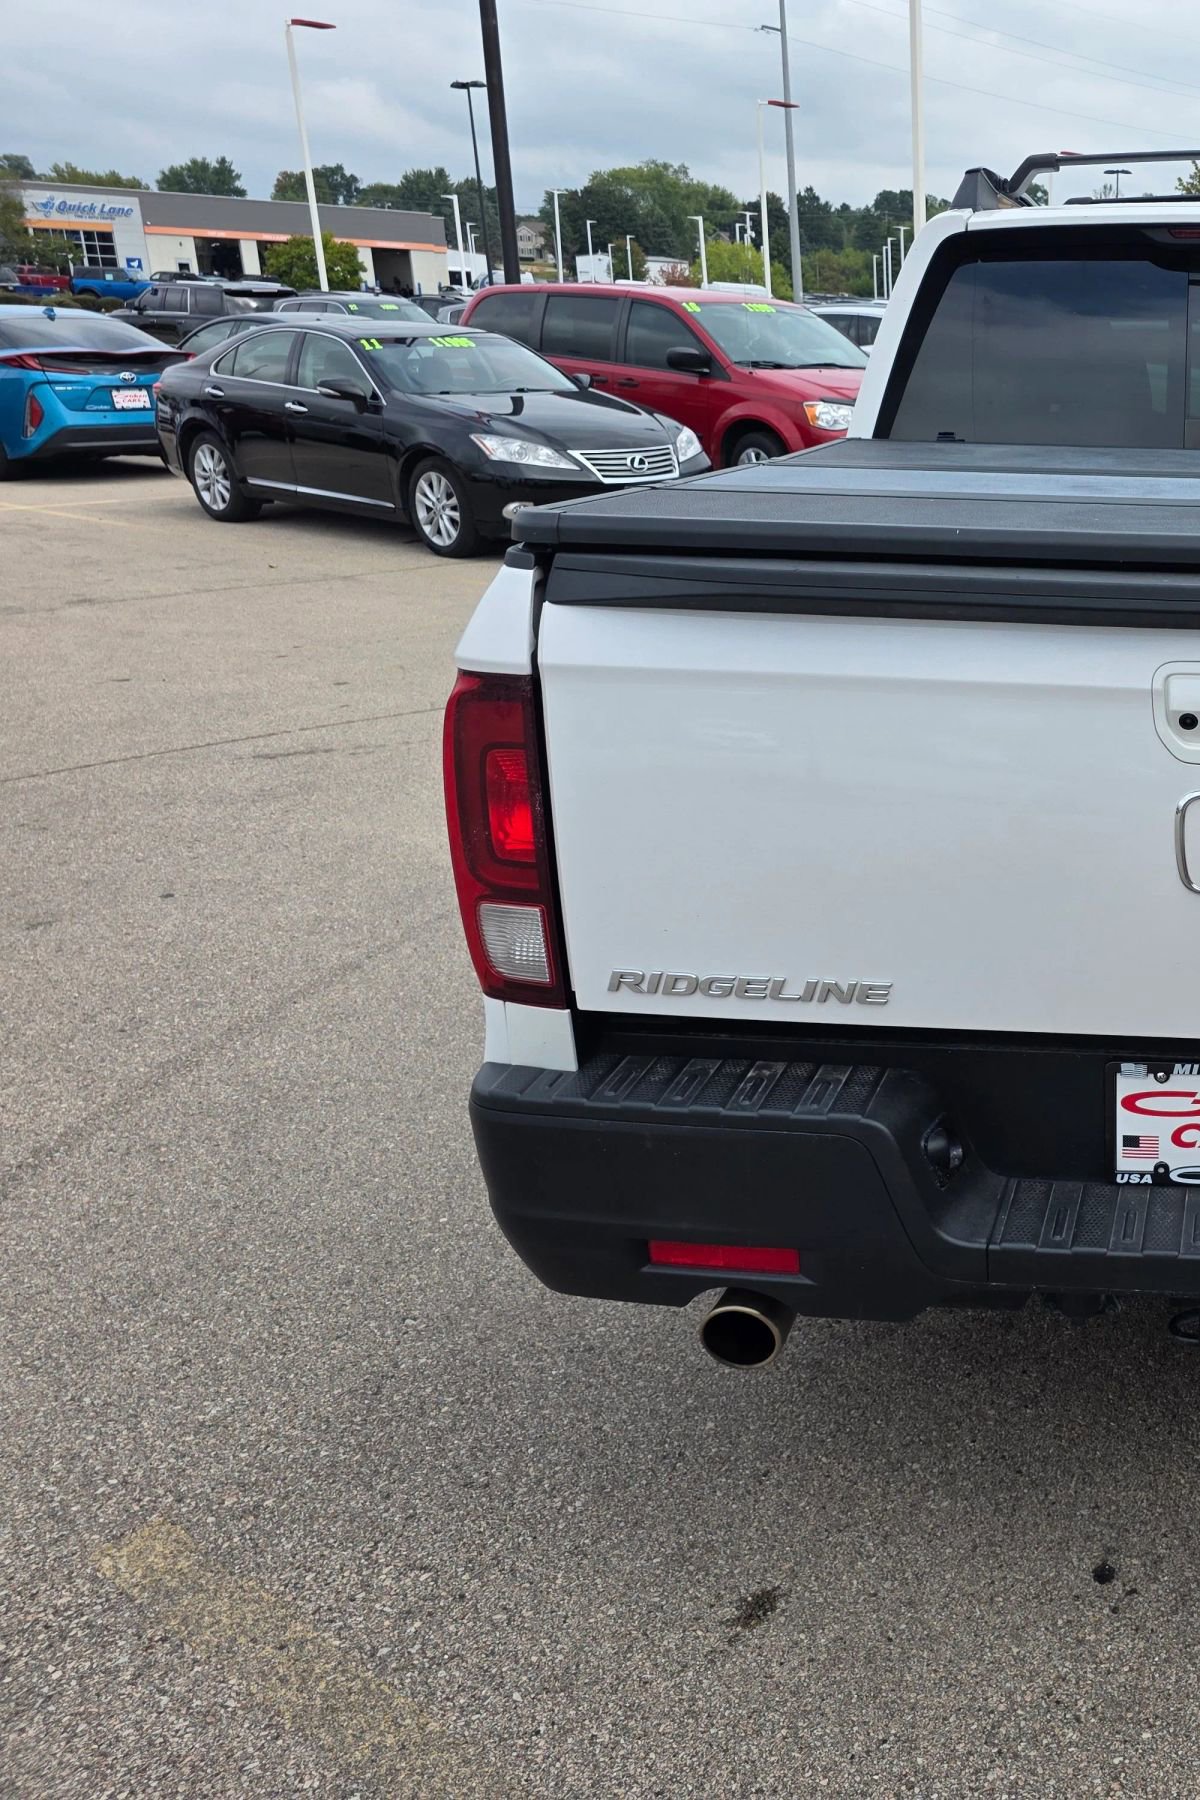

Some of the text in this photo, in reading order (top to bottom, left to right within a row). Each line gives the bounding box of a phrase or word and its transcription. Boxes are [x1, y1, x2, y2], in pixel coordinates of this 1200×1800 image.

[56, 200, 97, 214] Quick
[99, 203, 134, 217] Lane
[360, 338, 383, 350] 11
[607, 968, 893, 1005] RIDGELINE
[1116, 1173, 1153, 1184] USA
